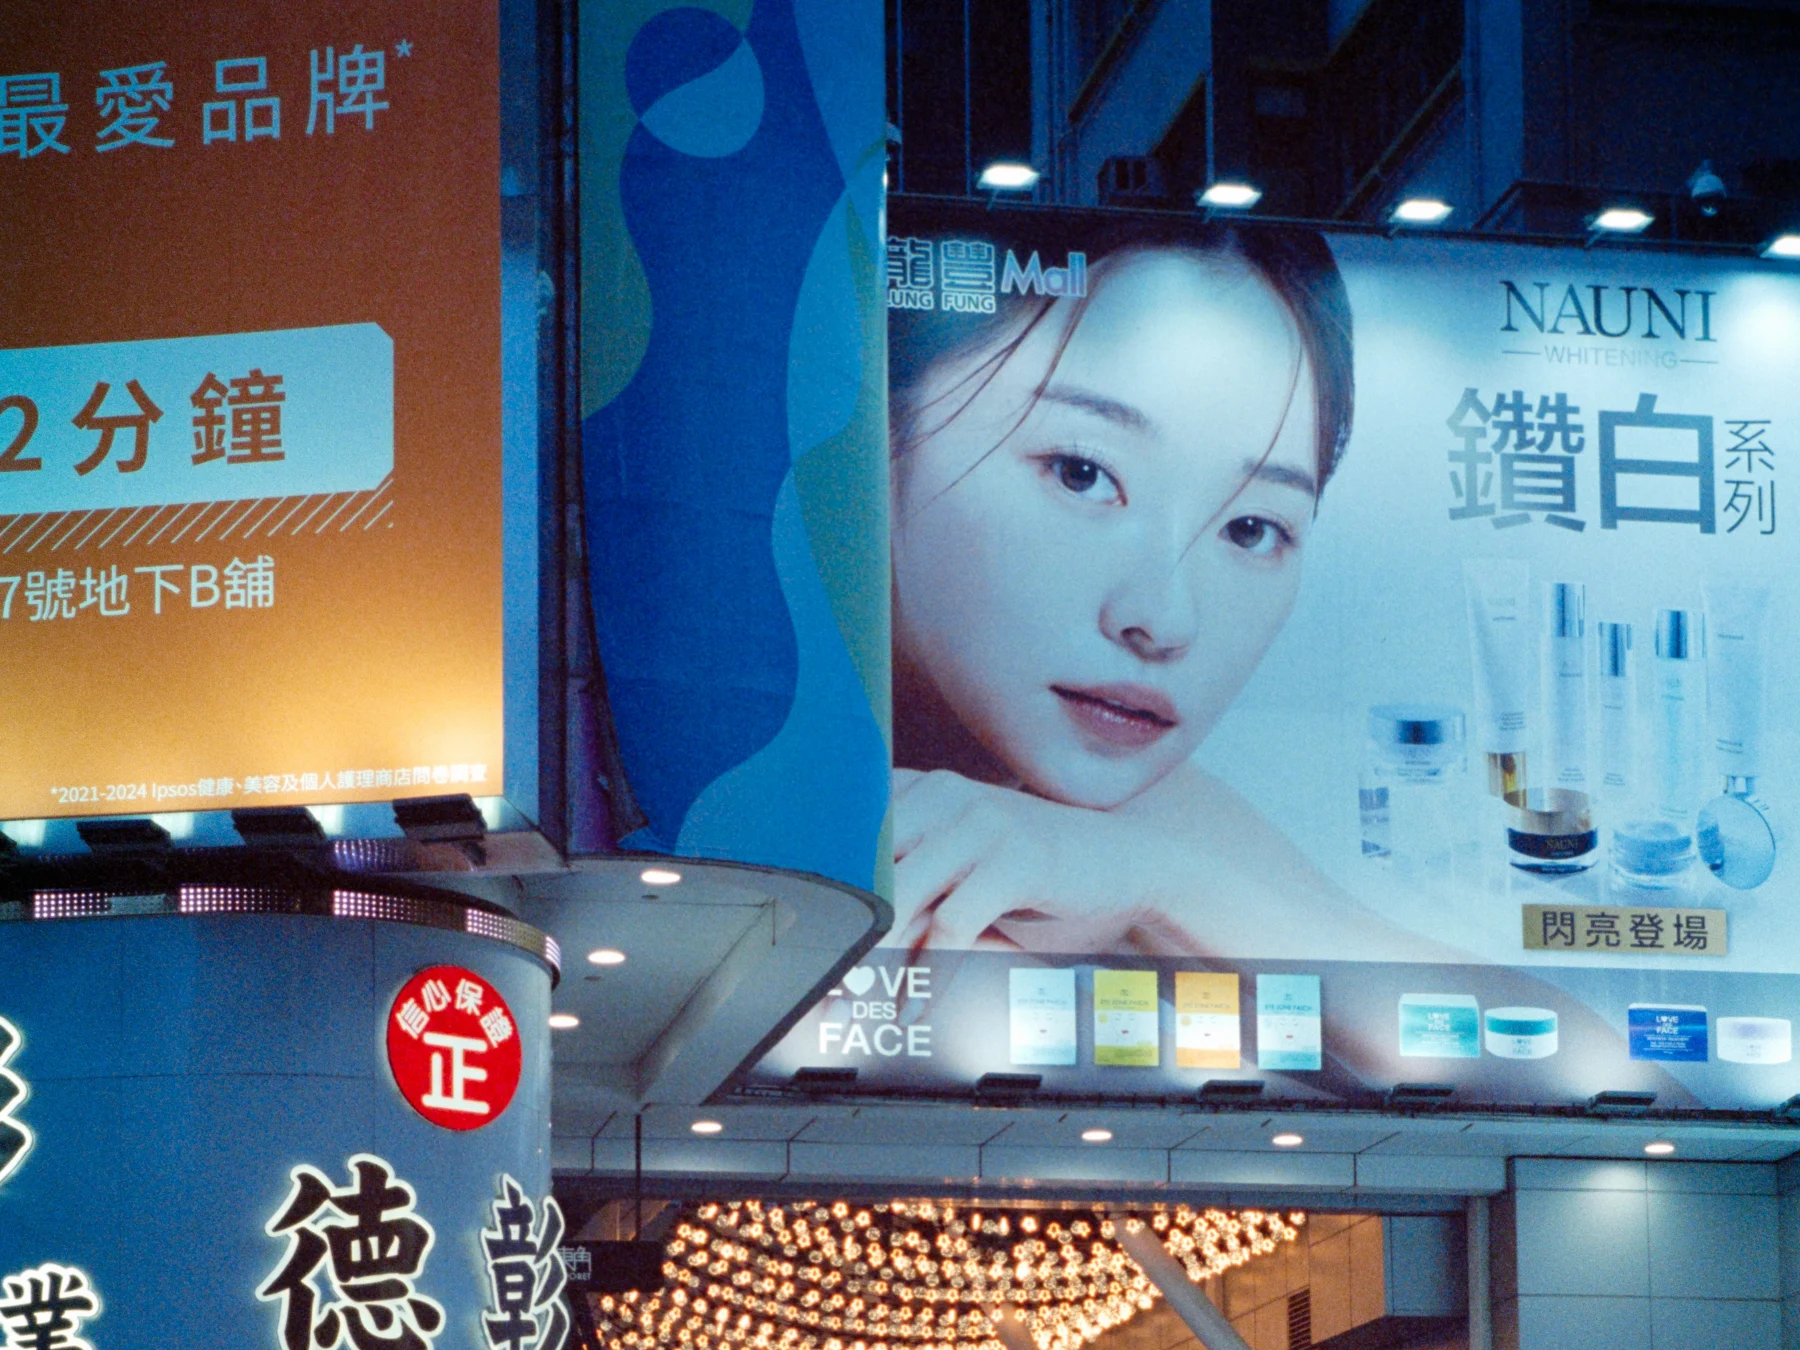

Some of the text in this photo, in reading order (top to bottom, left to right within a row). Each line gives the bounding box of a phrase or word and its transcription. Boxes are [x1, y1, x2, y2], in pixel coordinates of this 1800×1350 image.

[887, 237, 1086, 297] 龍豐 Mall
[941, 292, 996, 313] FUNG
[1500, 280, 1717, 342] NAUNI
[1545, 345, 1677, 370] WHITENING
[0, 368, 286, 477] 2分鐘
[1446, 387, 1716, 535] 鑽白
[1723, 419, 1776, 535] 系列
[1541, 910, 1709, 952] 閃亮登場
[396, 979, 513, 1048] 信心保證
[819, 1023, 932, 1057] FACE
[852, 1001, 897, 1020] DES
[1655, 1027, 1679, 1035] FACE
[421, 1031, 490, 1115] 正
